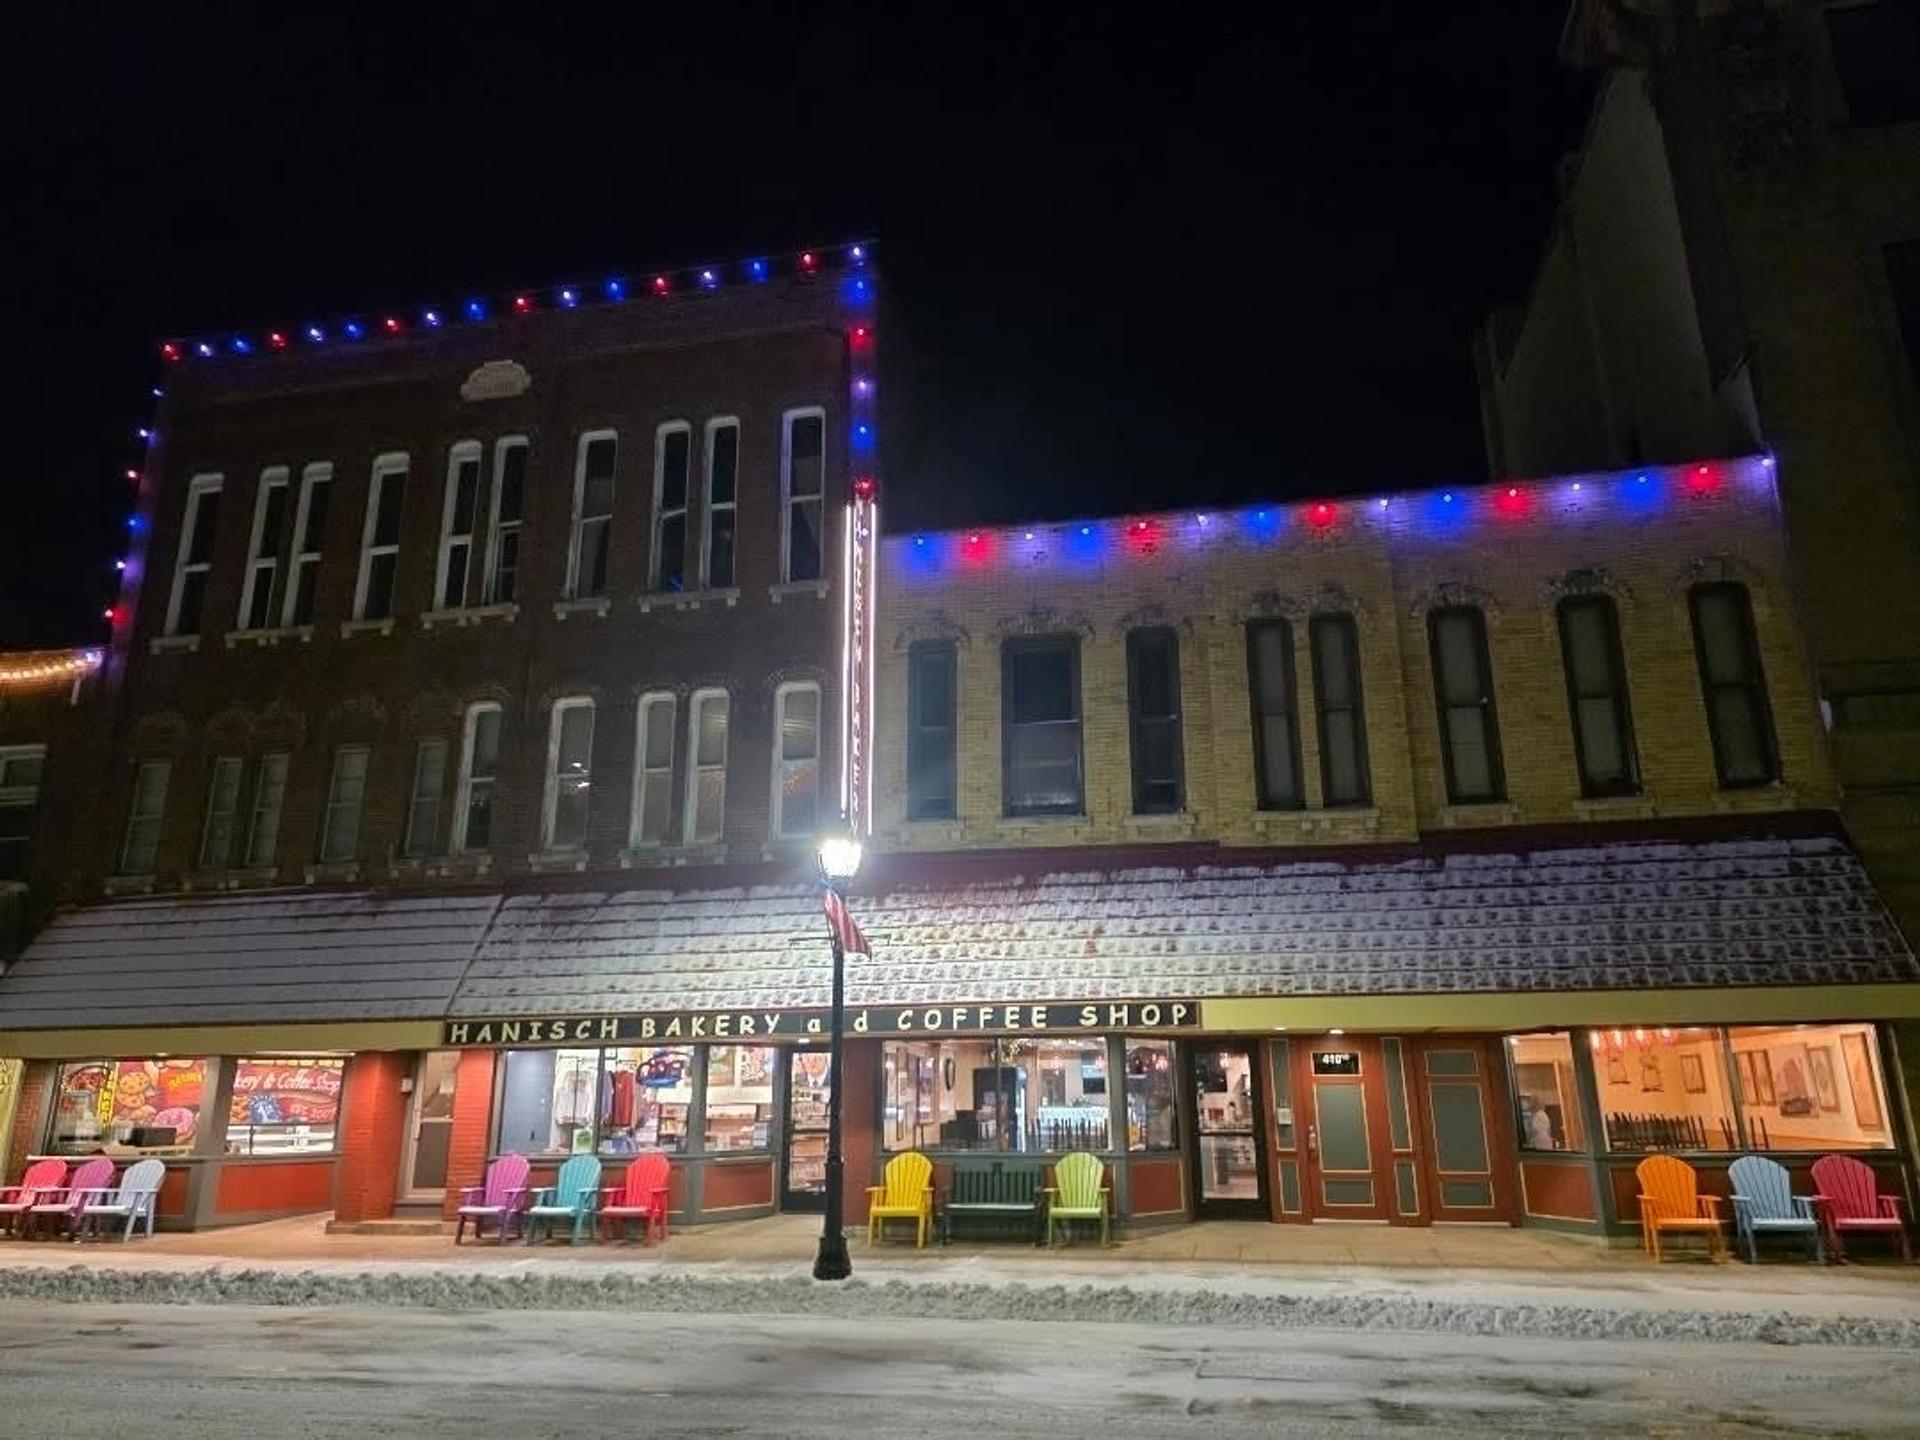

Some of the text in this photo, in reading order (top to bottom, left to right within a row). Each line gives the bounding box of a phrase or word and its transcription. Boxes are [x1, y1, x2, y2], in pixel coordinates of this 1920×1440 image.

[450, 1004, 1187, 1043] HANISCH BAKERY ad COFFEE SHOP
